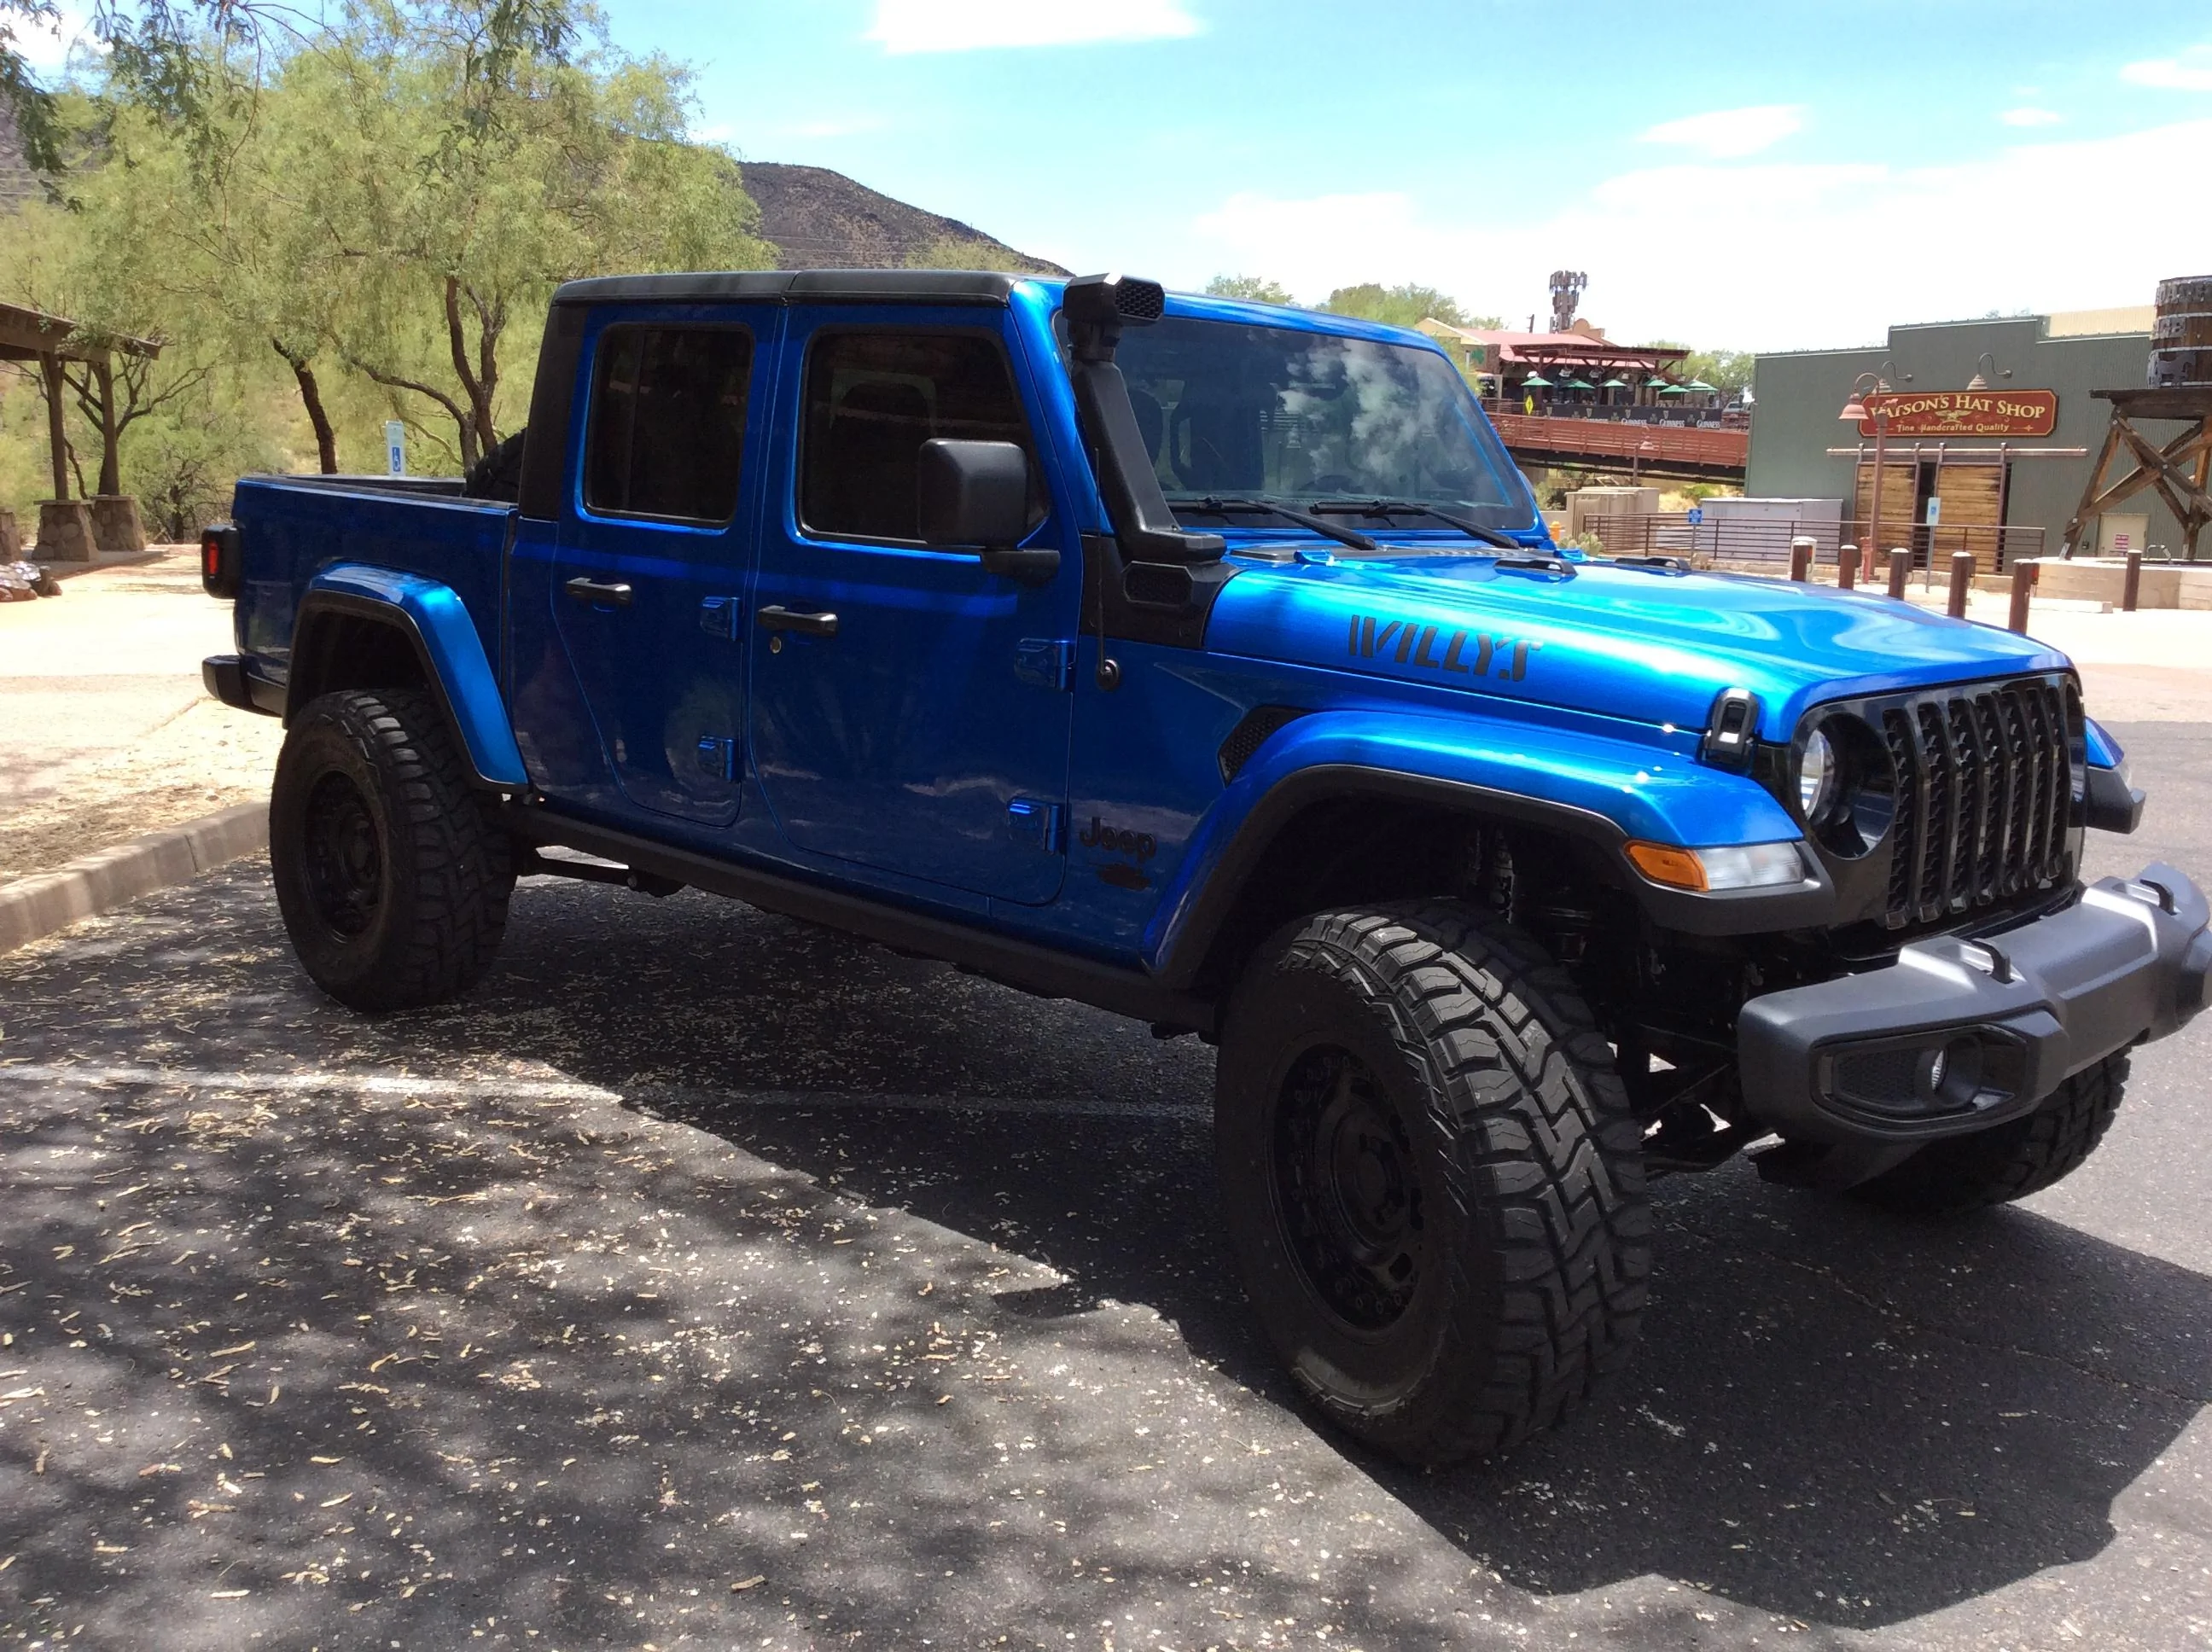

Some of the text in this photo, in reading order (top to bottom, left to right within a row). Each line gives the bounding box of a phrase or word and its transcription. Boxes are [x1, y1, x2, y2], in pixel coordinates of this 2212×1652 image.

[1955, 394, 1994, 412] HAT
[1997, 400, 2046, 419] SHOP
[1920, 422, 1973, 433] Handcrafted
[1976, 422, 2010, 433] Quality
[1080, 817, 1157, 864] Jeep
